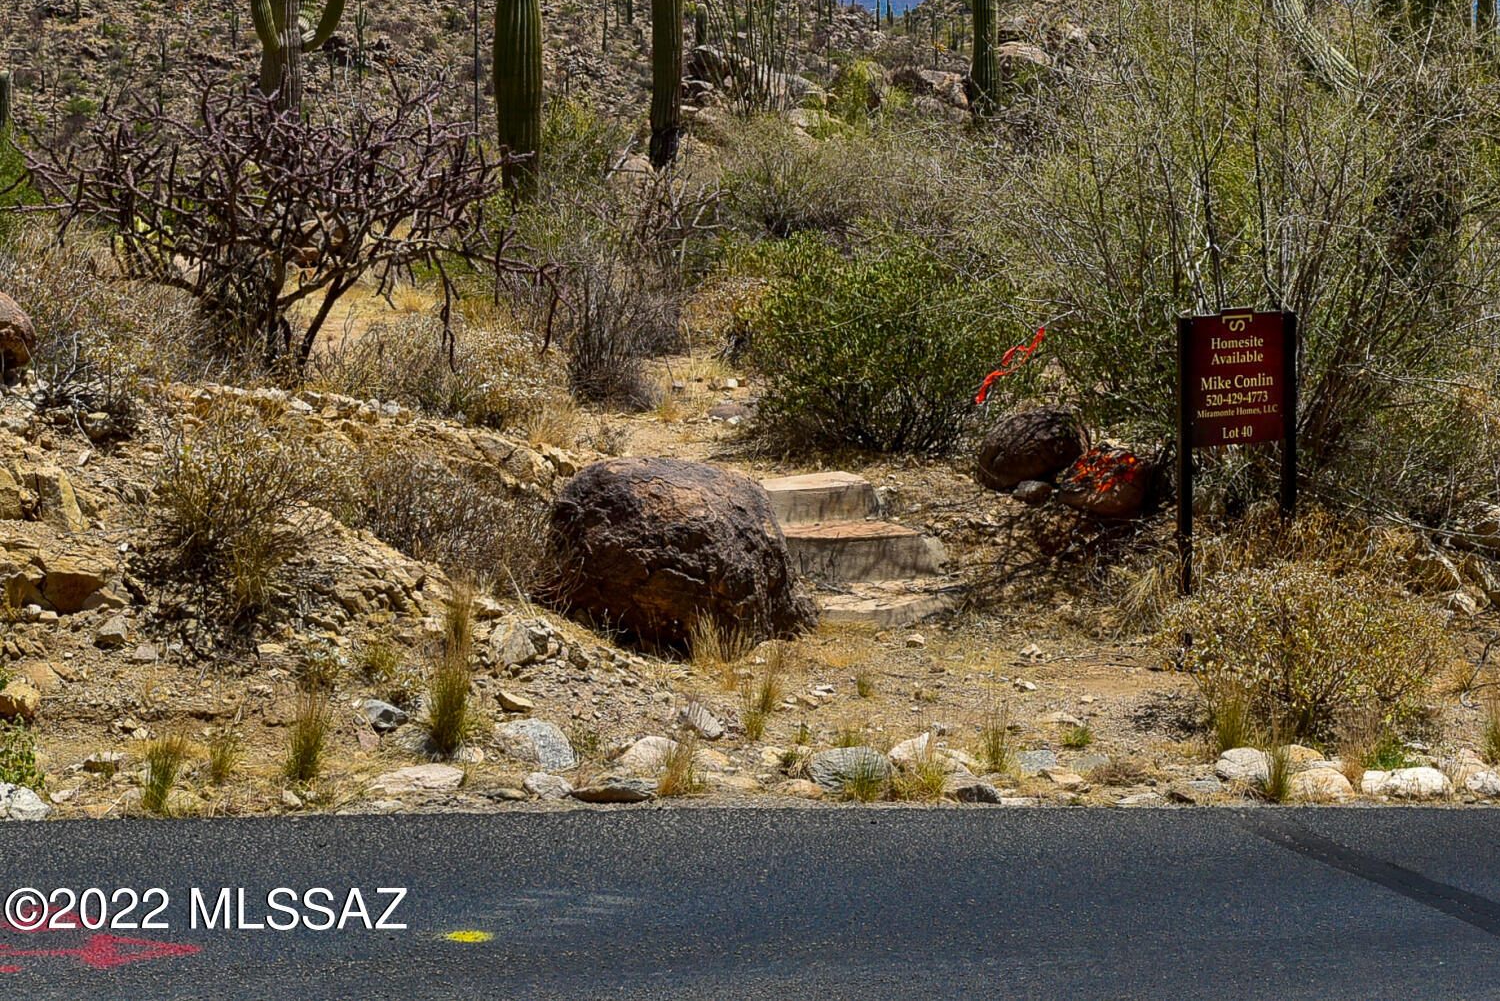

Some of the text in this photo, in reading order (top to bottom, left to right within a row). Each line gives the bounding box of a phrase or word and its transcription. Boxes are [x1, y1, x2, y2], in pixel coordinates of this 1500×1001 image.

[1211, 336, 1264, 349] Homesite
[1211, 351, 1264, 366] Available
[1200, 372, 1274, 390] Mike Conlin
[1205, 390, 1268, 407] 520-429-4773
[1197, 409, 1235, 418] Miramonte
[1263, 403, 1278, 414] LLC
[1222, 425, 1253, 438] Lot 40
